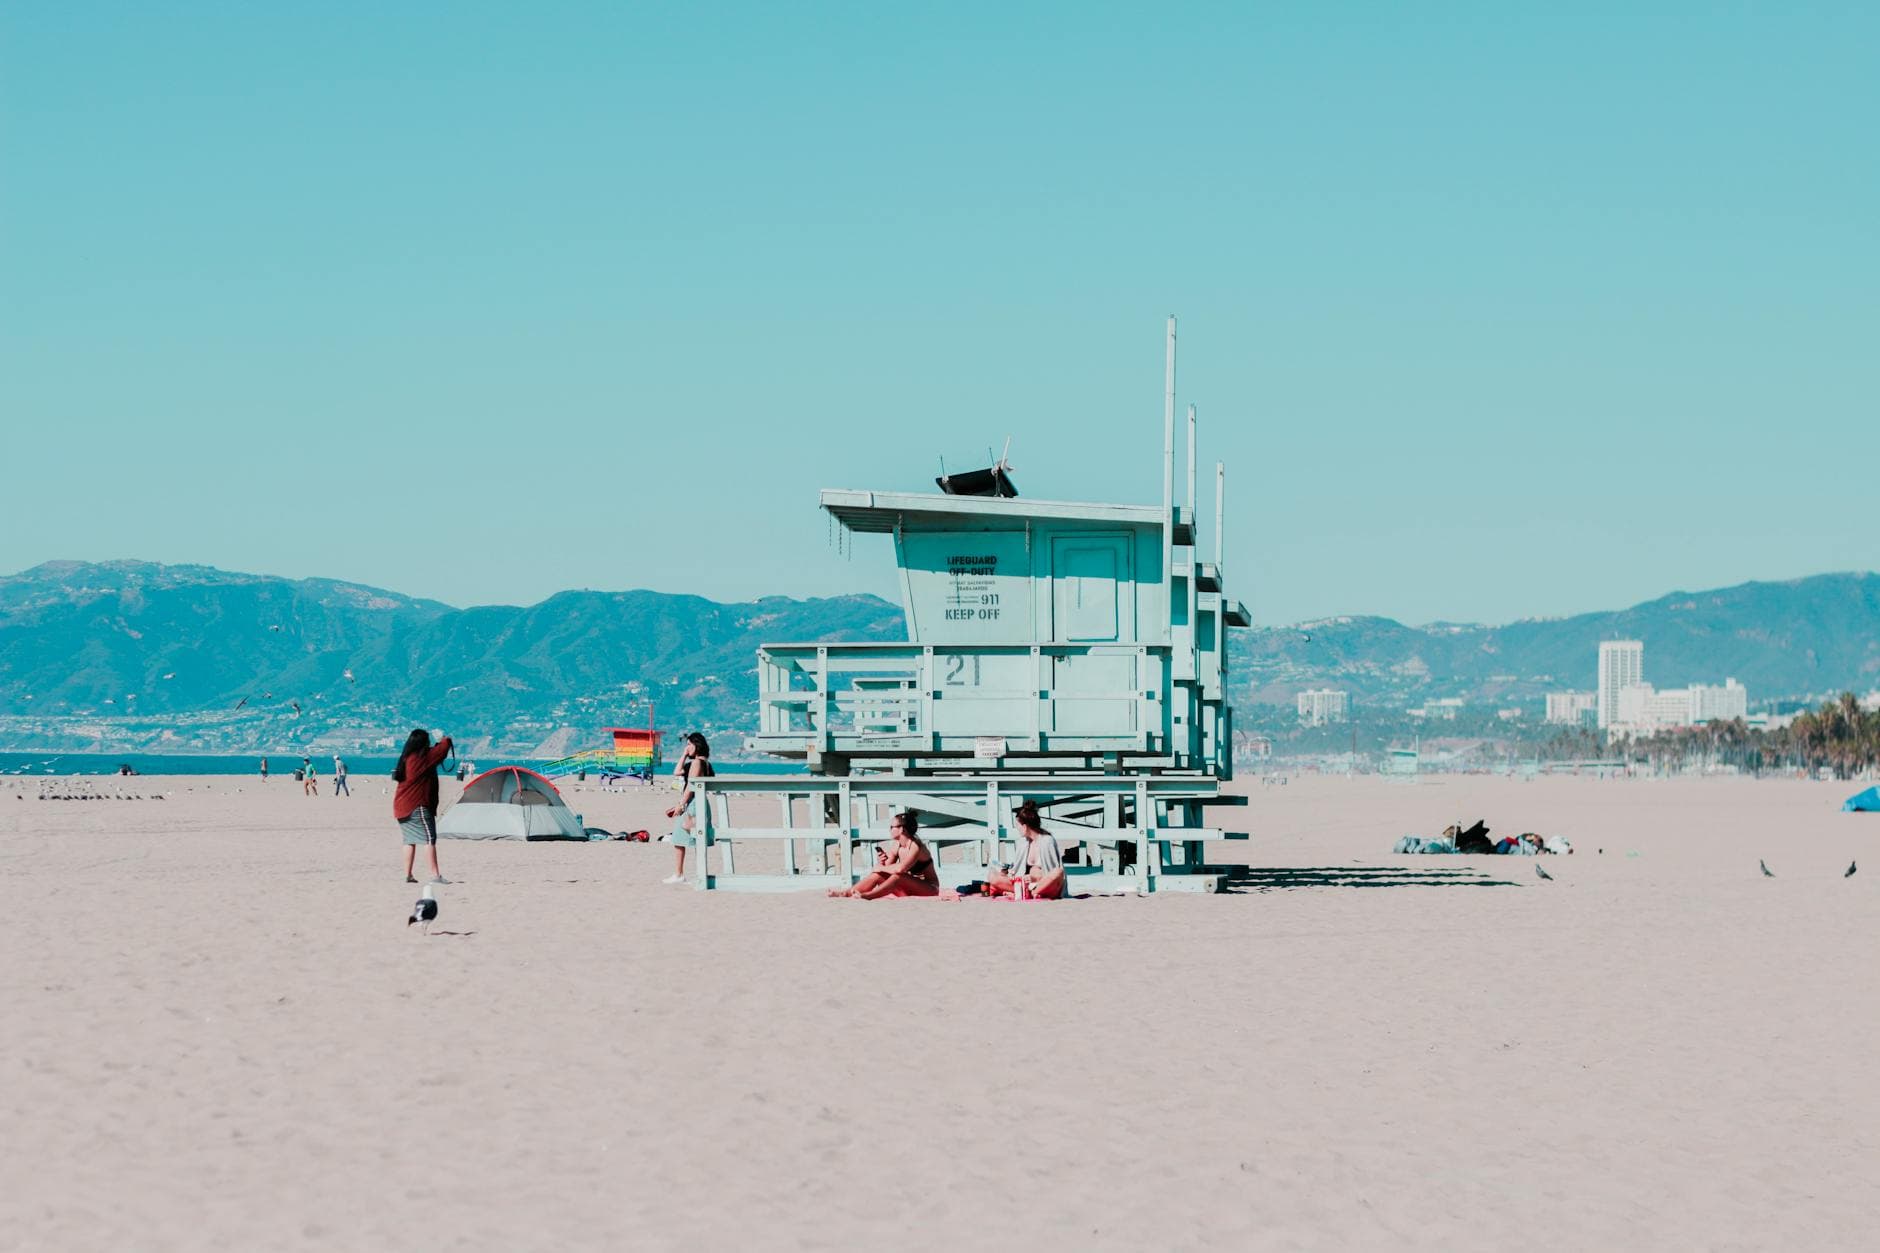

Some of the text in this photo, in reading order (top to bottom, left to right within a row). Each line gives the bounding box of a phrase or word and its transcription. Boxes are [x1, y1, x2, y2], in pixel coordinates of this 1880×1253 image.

[947, 556, 997, 565] LIFEGUARD
[949, 567, 995, 576] OFF-DUTY
[981, 594, 999, 605] 911
[945, 609, 1000, 620] KEEP OFF
[946, 655, 980, 686] 21
